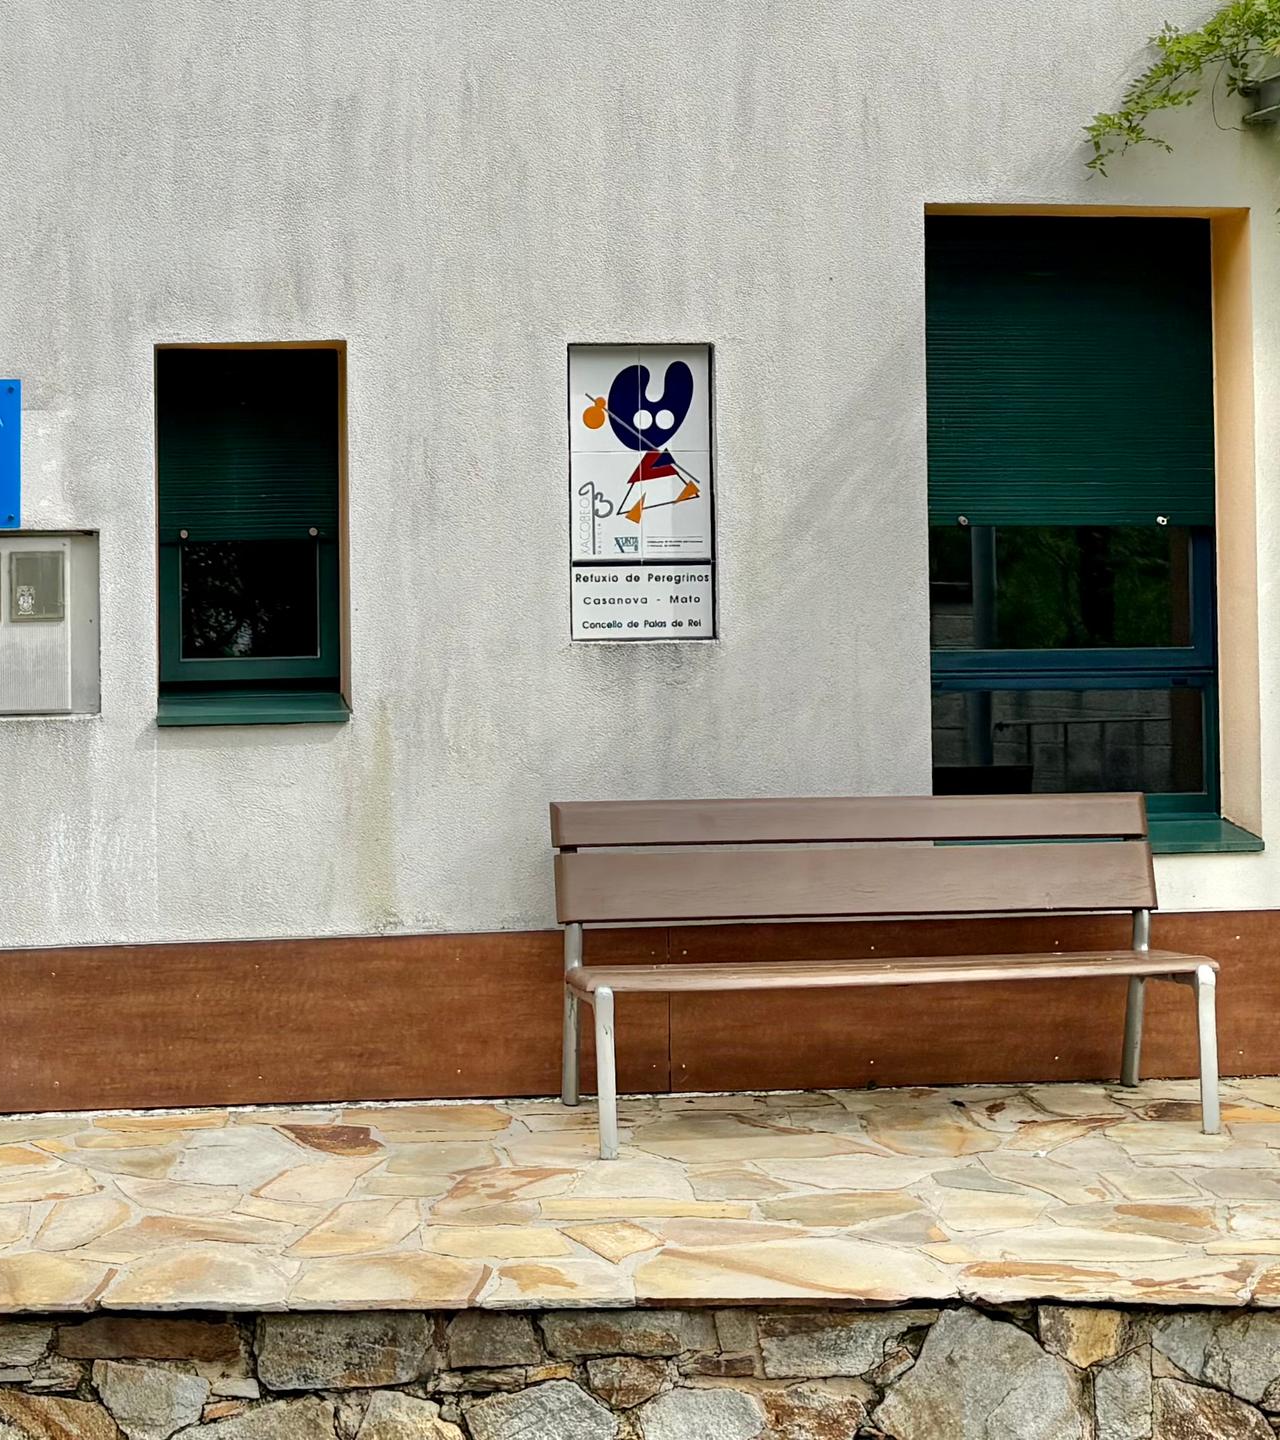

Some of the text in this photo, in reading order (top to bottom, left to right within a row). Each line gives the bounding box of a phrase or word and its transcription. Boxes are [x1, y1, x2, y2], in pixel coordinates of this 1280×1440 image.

[575, 572, 710, 584] Refuxio de Peregrinos
[583, 596, 648, 605] Casanova
[669, 595, 701, 604] Mato
[582, 618, 702, 629] Concello de Palas de Rei
